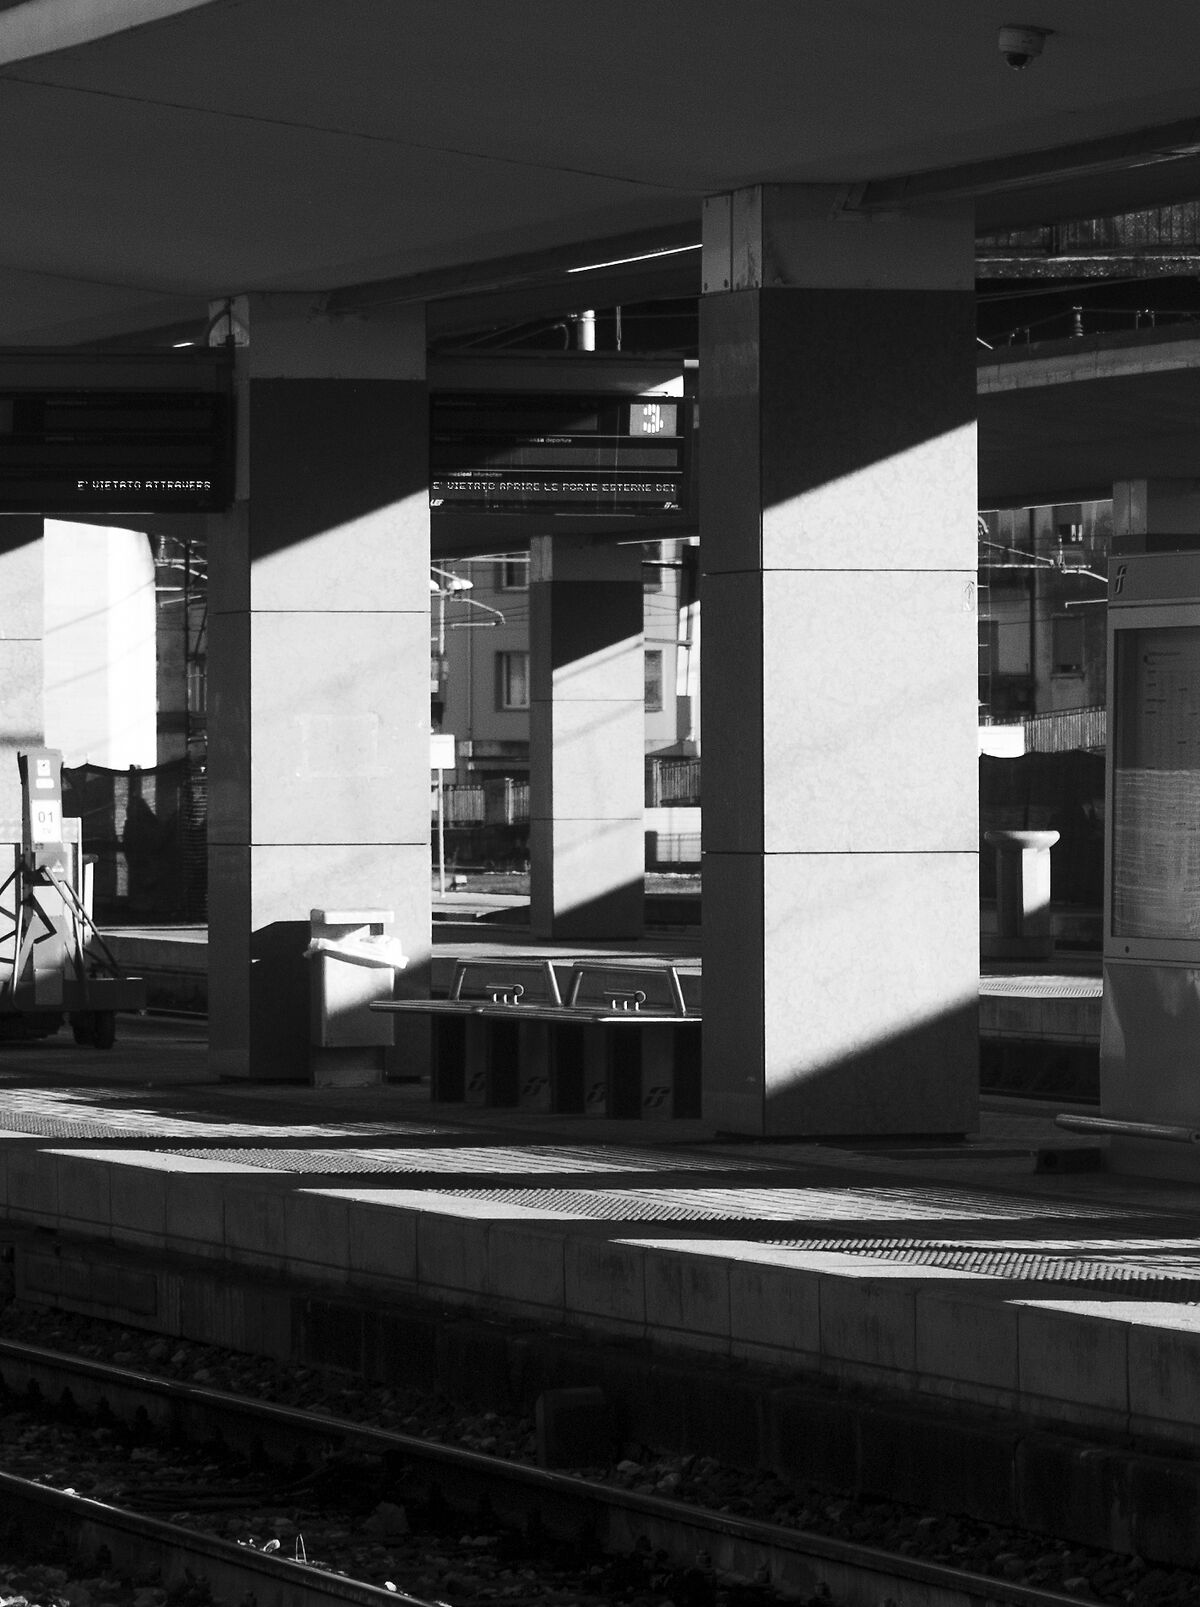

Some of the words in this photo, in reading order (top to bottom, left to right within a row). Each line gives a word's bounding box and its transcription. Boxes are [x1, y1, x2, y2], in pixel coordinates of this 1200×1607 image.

[643, 404, 664, 434] 3
[92, 480, 141, 491] VIETATO
[447, 481, 496, 490] VIETATO
[499, 481, 540, 491] APRIRE
[543, 482, 559, 492] LE
[562, 482, 598, 492] PORTE
[602, 482, 652, 492] ESTERNE
[655, 482, 677, 492] DEI
[38, 811, 53, 823] 01
